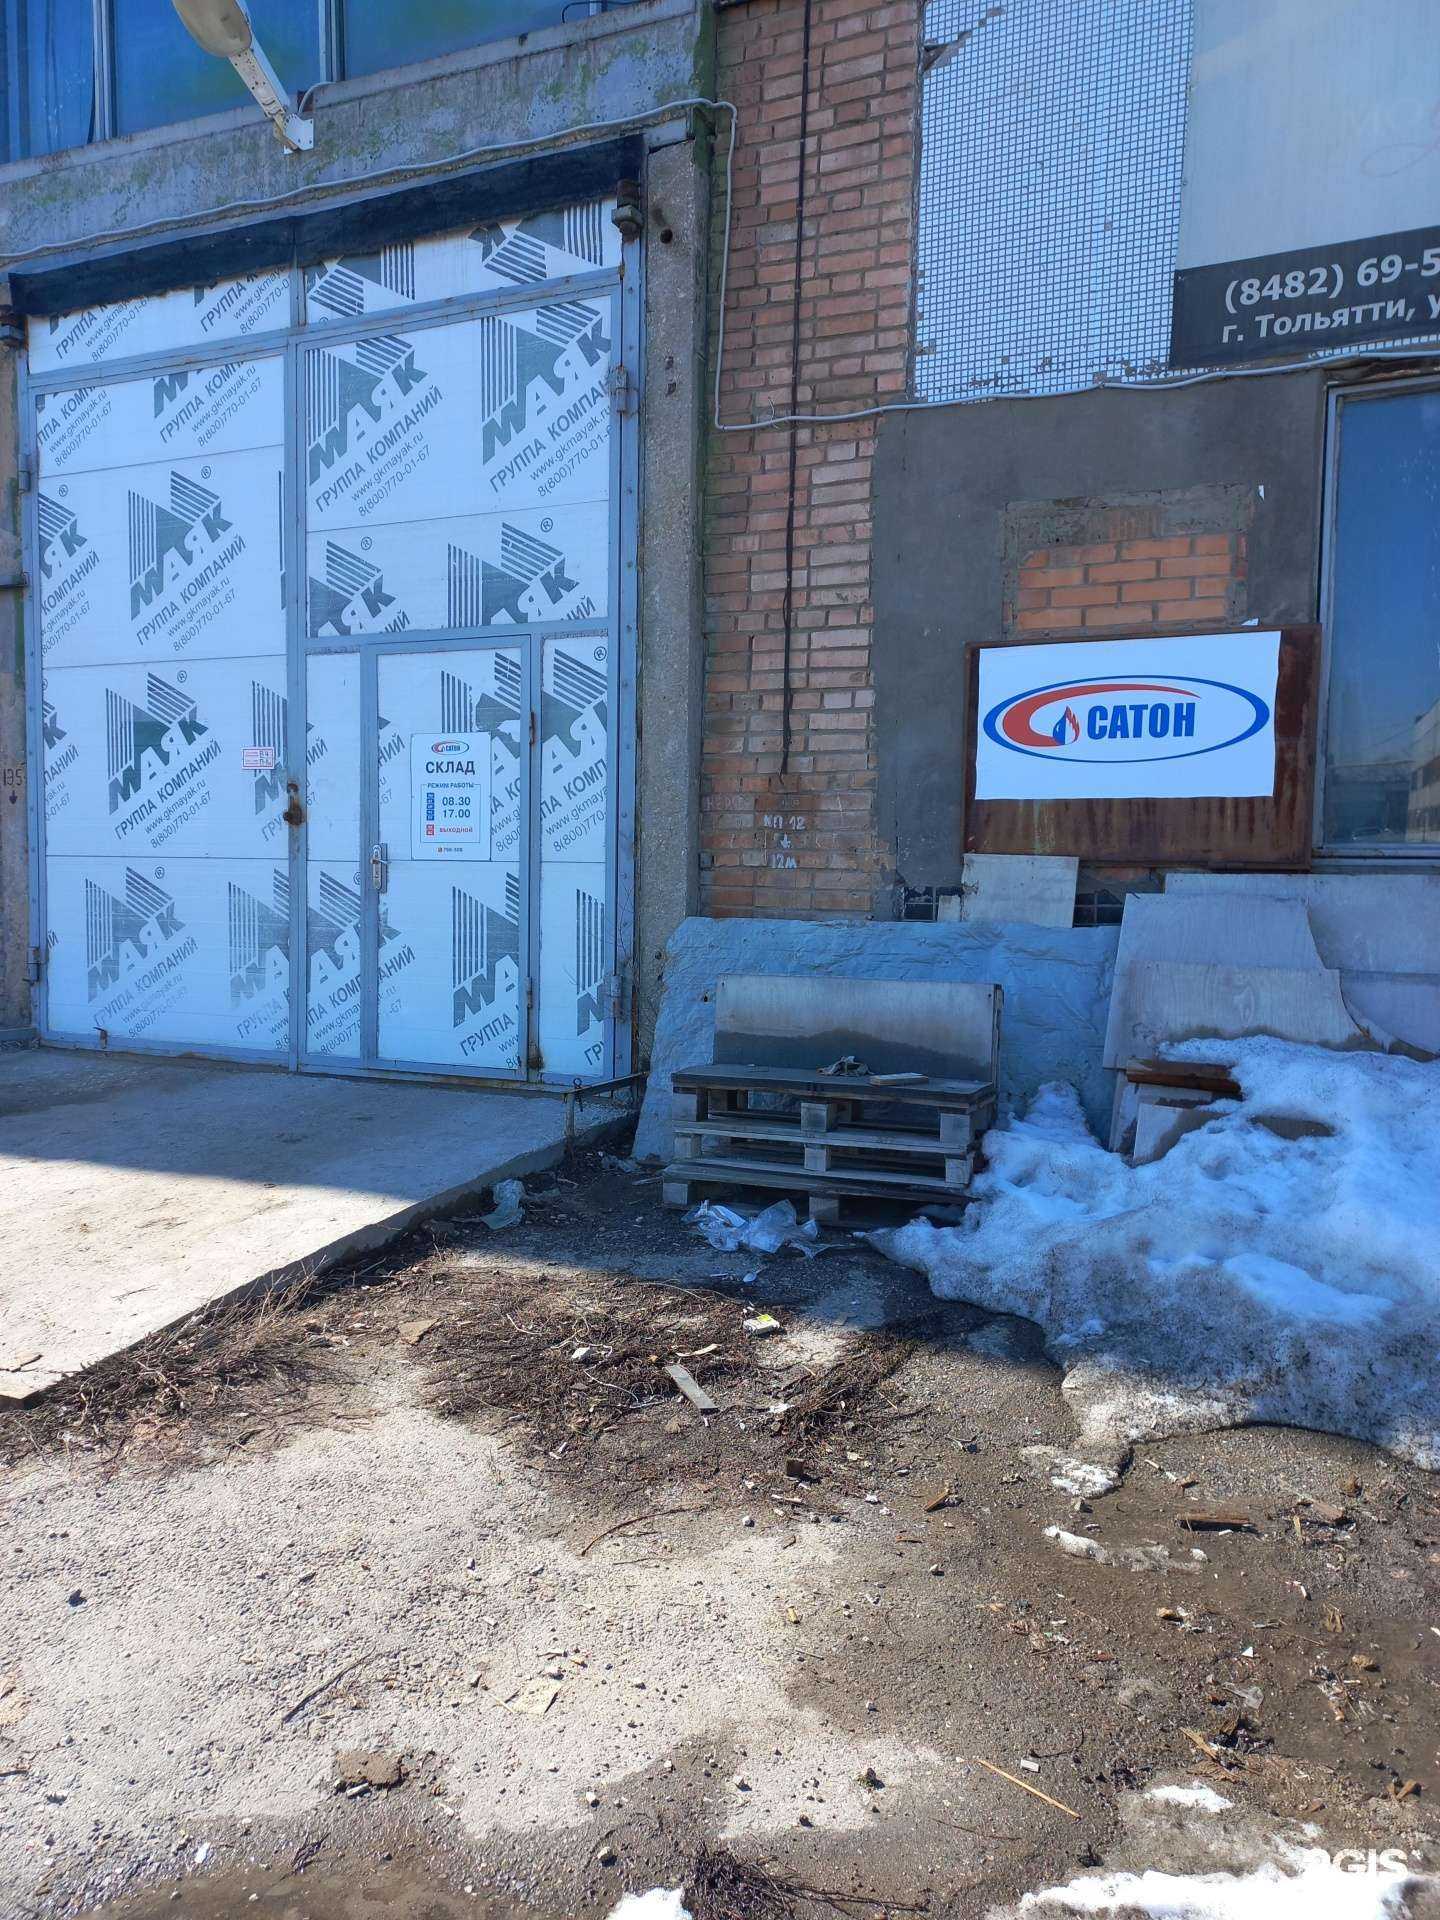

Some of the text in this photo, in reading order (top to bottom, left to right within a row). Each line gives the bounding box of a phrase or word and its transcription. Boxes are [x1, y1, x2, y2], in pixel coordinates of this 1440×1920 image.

[200, 281, 247, 333] ГРУППА
[1225, 263, 1344, 315] (8482)
[55, 311, 98, 359] ГРУППА
[1222, 325, 1244, 344] г.
[1254, 297, 1416, 339] Тольятти,
[49, 390, 108, 454] www.gkmayak.ru
[160, 395, 205, 444] ГРУППА
[191, 365, 256, 433] www.gkmayak.ru
[197, 377, 262, 447] 8(800)770-01-67
[54, 401, 112, 467] 8(800)770-01-67
[314, 384, 444, 512] ГРУППА КОМПАНИЙ
[351, 432, 425, 503] www.gkmayak.ru
[358, 445, 432, 517] 8(800)770-01-67
[489, 438, 547, 493] ГРУППА
[41, 550, 100, 615] КОМПАНИЙ
[136, 601, 181, 646] ГРУППА
[180, 534, 247, 604] КОМПАНИЙ
[167, 576, 230, 637] www.gkmayak.ru
[173, 588, 236, 652] 8(800)770-01-67
[1087, 702, 1196, 740] САТОН
[115, 799, 157, 840] ГРУППА
[157, 738, 223, 803] КОМПАНИЙ
[425, 761, 475, 775] СКЛАД
[145, 780, 207, 835] www.gkmayak.ru
[151, 791, 212, 849] 8(800)770-01-67
[442, 797, 471, 806] 08.30
[443, 809, 471, 818] 17.00
[93, 936, 199, 1026] ГРУППА КОМПАНИЙ
[459, 1013, 515, 1057] ГРУППА
